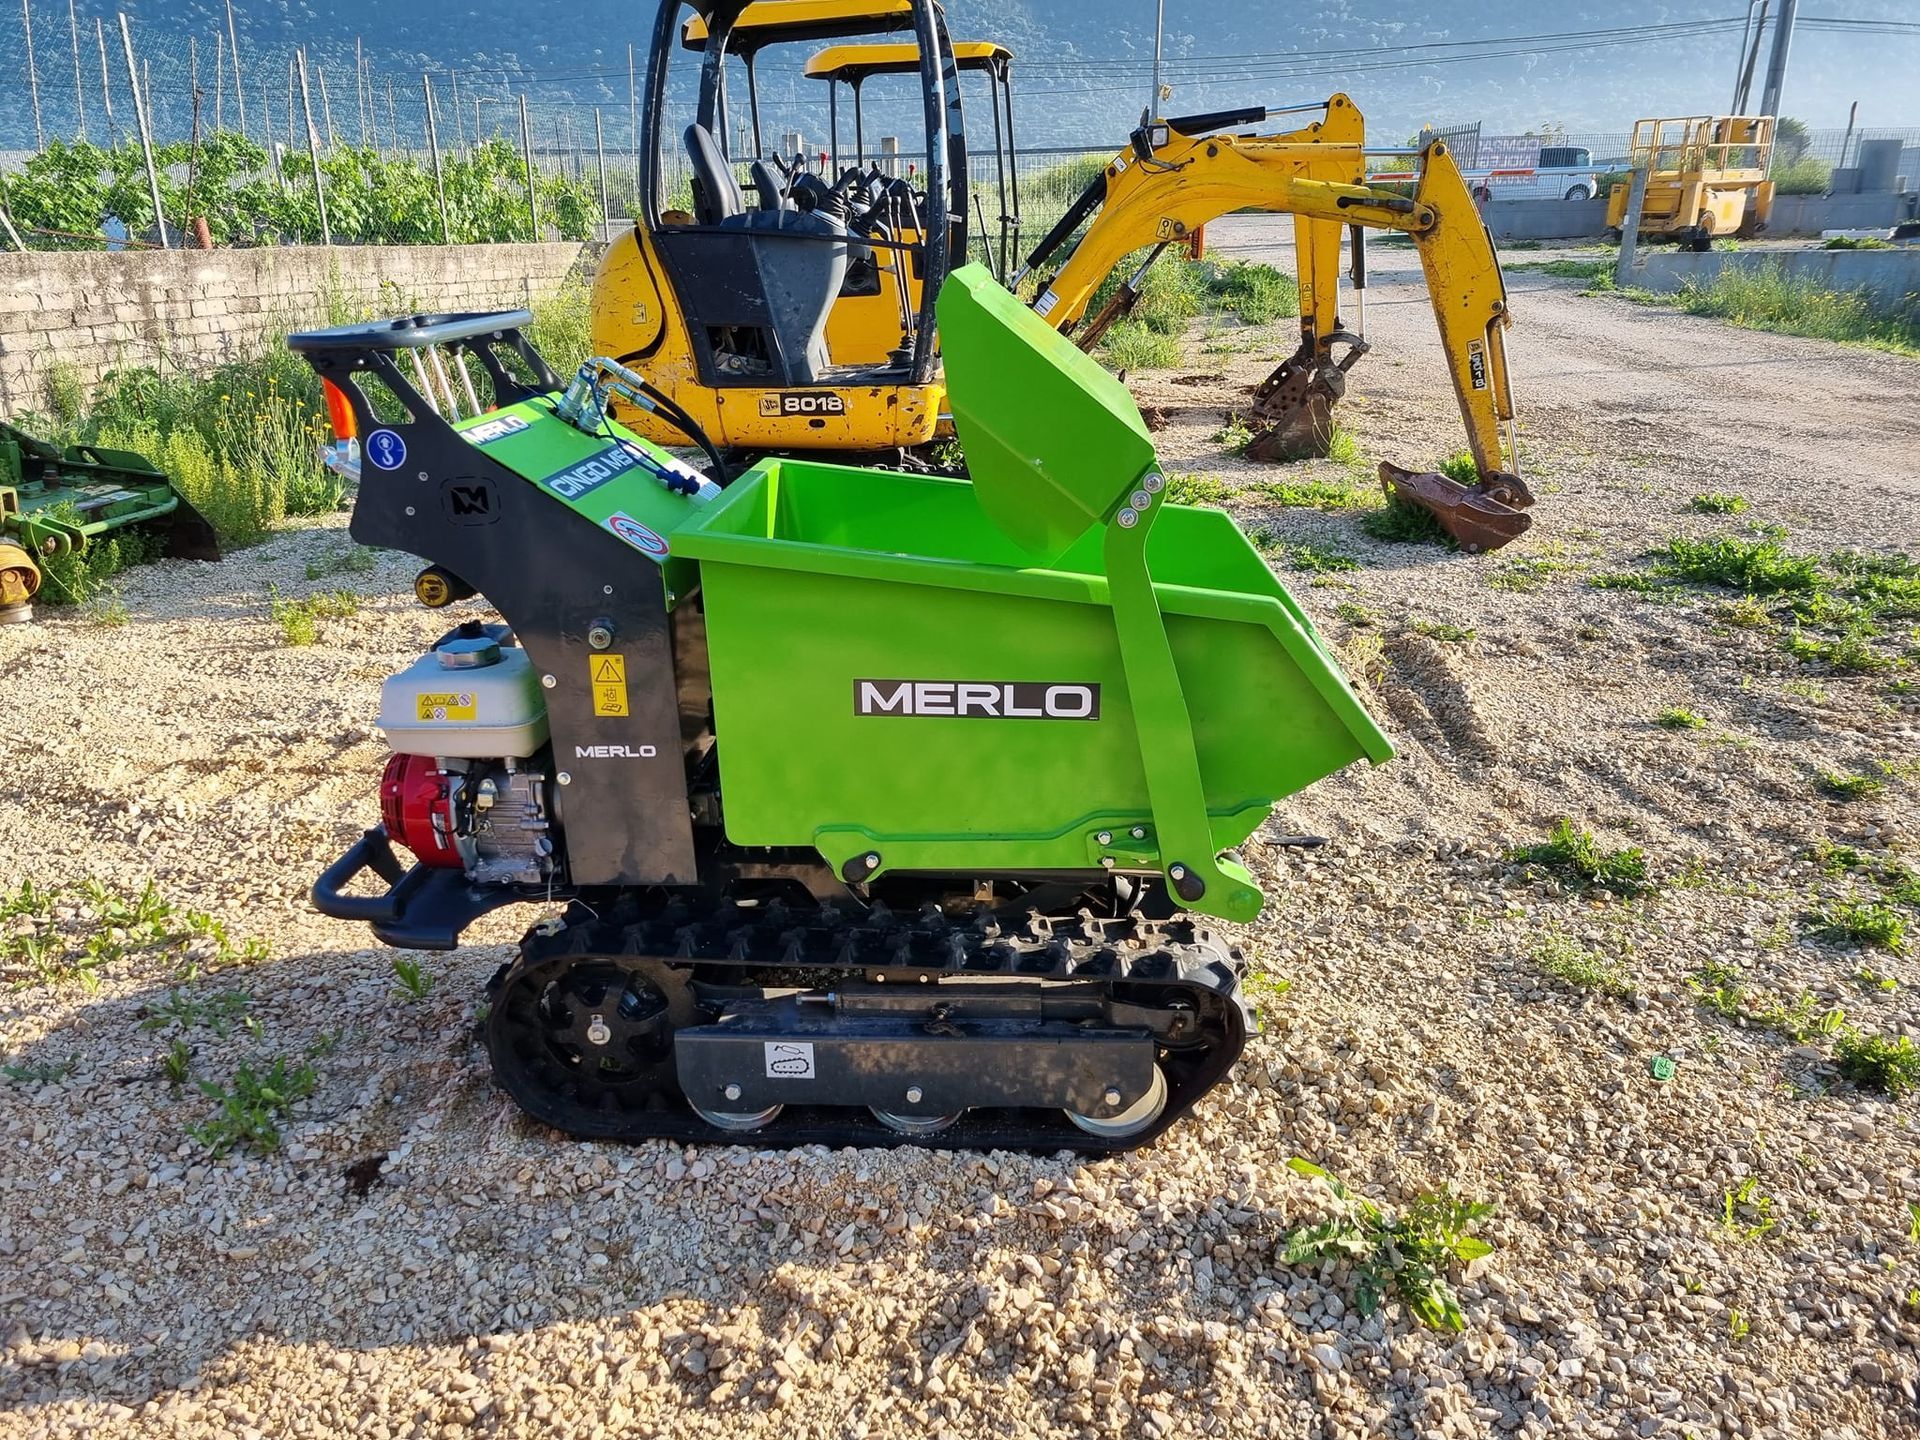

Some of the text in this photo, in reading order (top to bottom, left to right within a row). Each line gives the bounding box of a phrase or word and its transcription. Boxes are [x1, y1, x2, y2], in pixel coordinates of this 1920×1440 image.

[784, 396, 843, 412] 8018
[460, 415, 530, 445] MERLO
[549, 461, 613, 497] CINGO
[860, 681, 1092, 718] MERLO
[575, 744, 657, 759] MERLO
